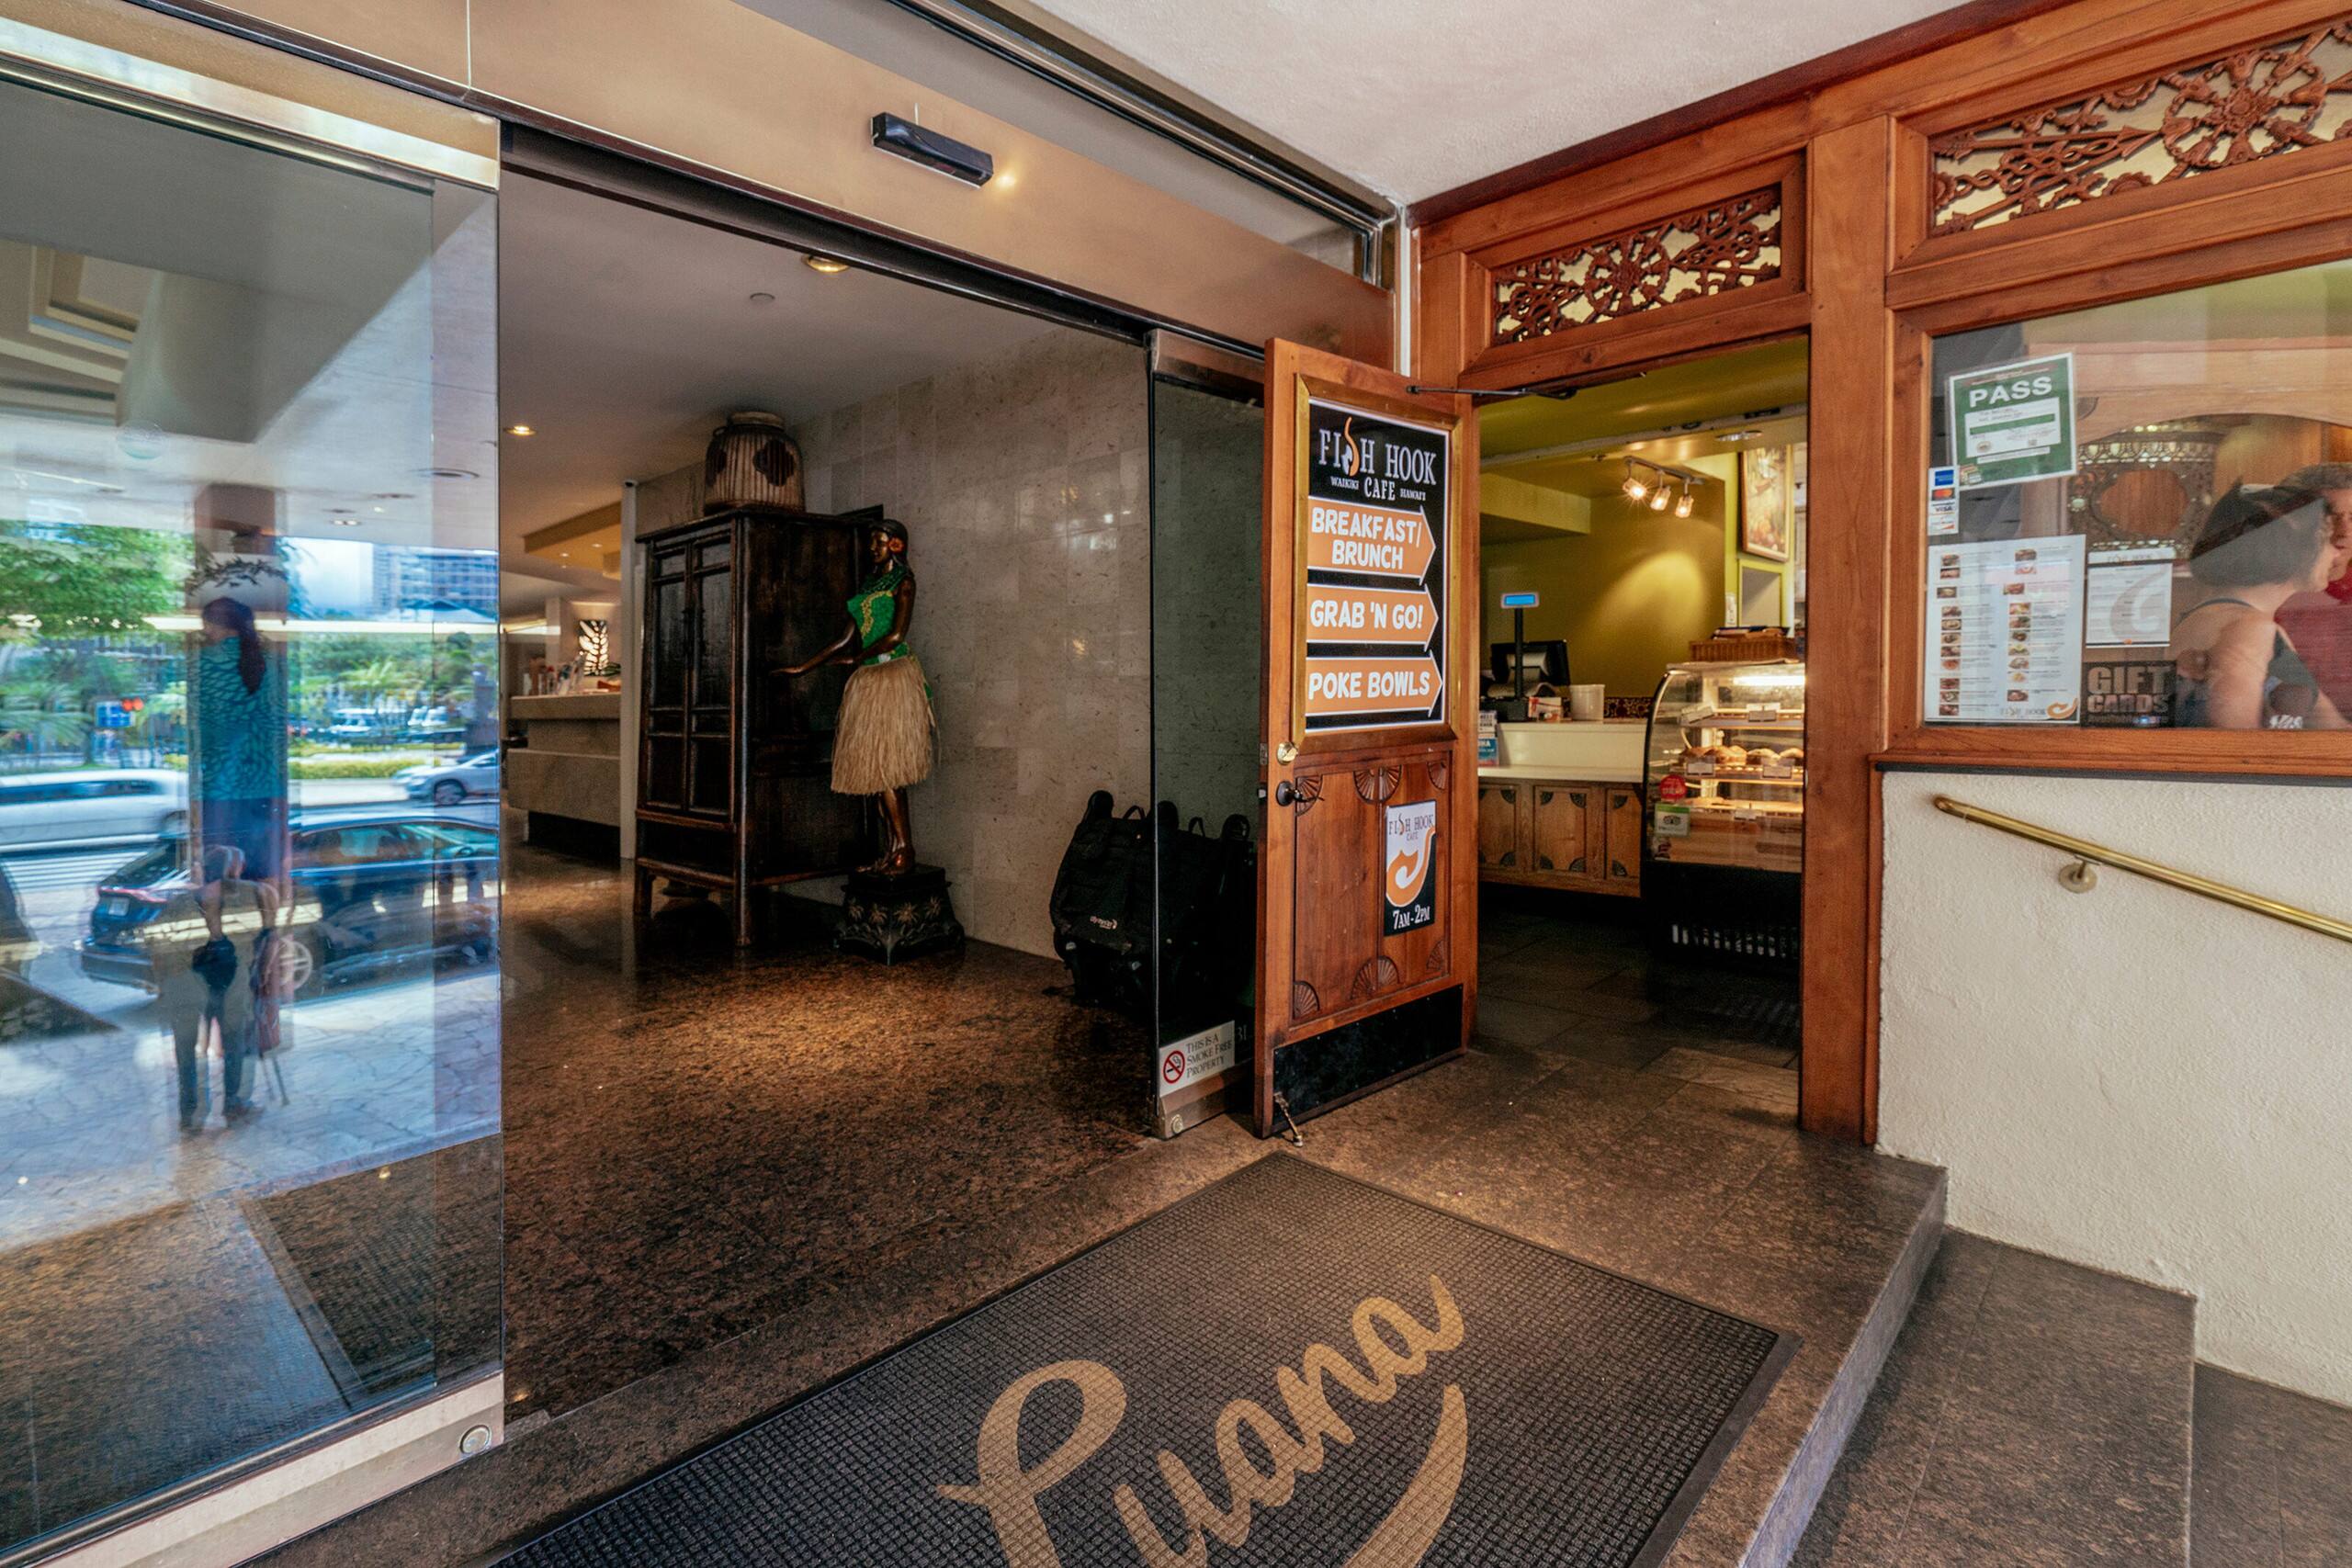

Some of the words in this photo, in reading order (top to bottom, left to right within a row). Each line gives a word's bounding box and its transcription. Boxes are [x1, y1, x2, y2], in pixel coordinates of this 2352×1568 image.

[1969, 376, 2052, 408] PASS
[1318, 416, 1375, 477] FISH
[1385, 444, 1437, 485] HOOK
[1330, 476, 1360, 490] WAIKIKI
[1363, 477, 1396, 501] CAFE
[1311, 507, 1422, 547] BREAKFAST/
[1332, 539, 1404, 570] BRUNCH
[1309, 599, 1365, 628] GRAB
[1370, 602, 1387, 629] 'N
[1392, 604, 1423, 629] GO!
[1307, 671, 1363, 700] POKE
[1367, 671, 1430, 698] BOWLS
[2086, 665, 2172, 694] GIFT
[2086, 694, 2169, 714] CARDS
[1388, 813, 1411, 835] FISH
[1414, 814, 1434, 830] HOOK
[1186, 1039, 1205, 1054] THIS
[1205, 1035, 1213, 1046] IS
[1213, 1032, 1219, 1043] A
[1186, 1047, 1213, 1065] SMOKE
[1215, 1040, 1233, 1055] FREE
[1186, 1055, 1225, 1078] PROPERTY
